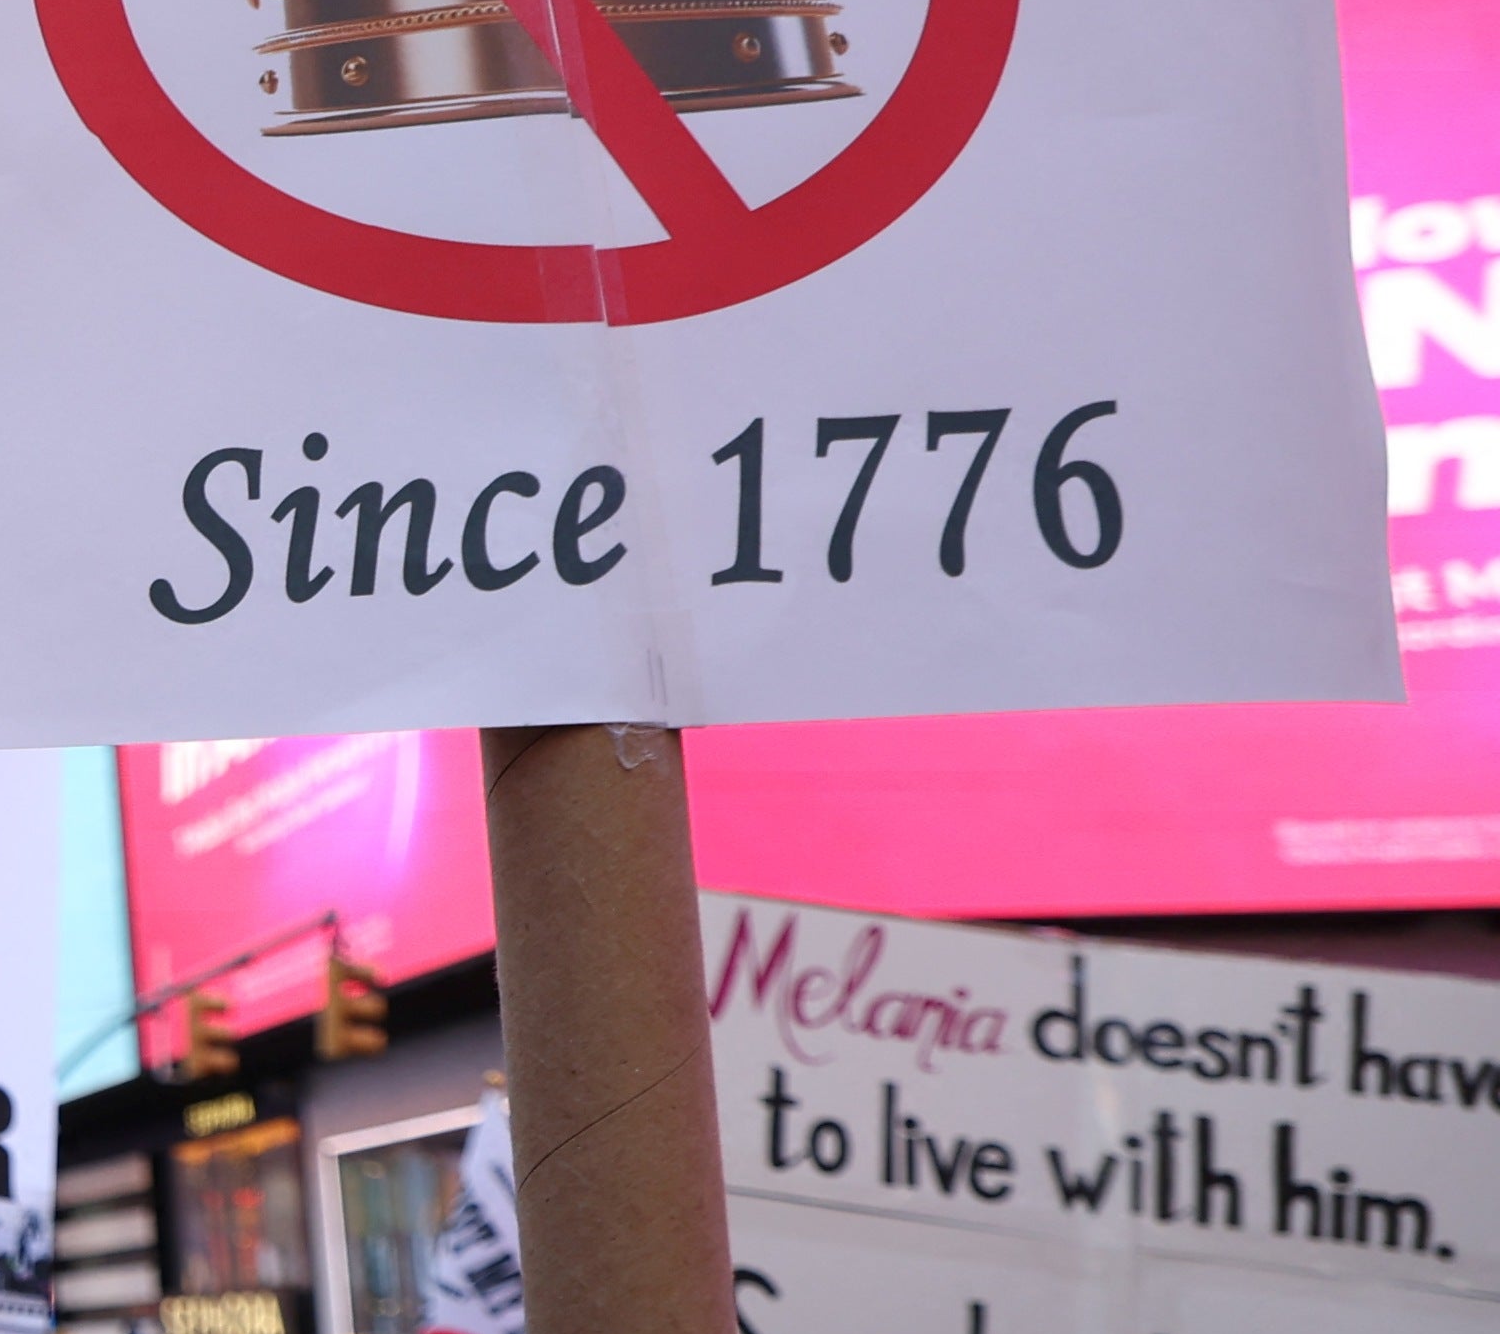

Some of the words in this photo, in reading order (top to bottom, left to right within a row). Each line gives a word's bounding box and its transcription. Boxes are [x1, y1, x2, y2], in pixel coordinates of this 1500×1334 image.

[148, 431, 628, 625] Since
[710, 399, 1124, 587] 1776
[709, 908, 1011, 1072] Melania
[1031, 955, 1332, 1086] doesn't
[758, 1067, 852, 1173] to
[880, 1081, 1015, 1202] live
[1046, 1110, 1243, 1233] with
[1274, 1122, 1457, 1261] him.
